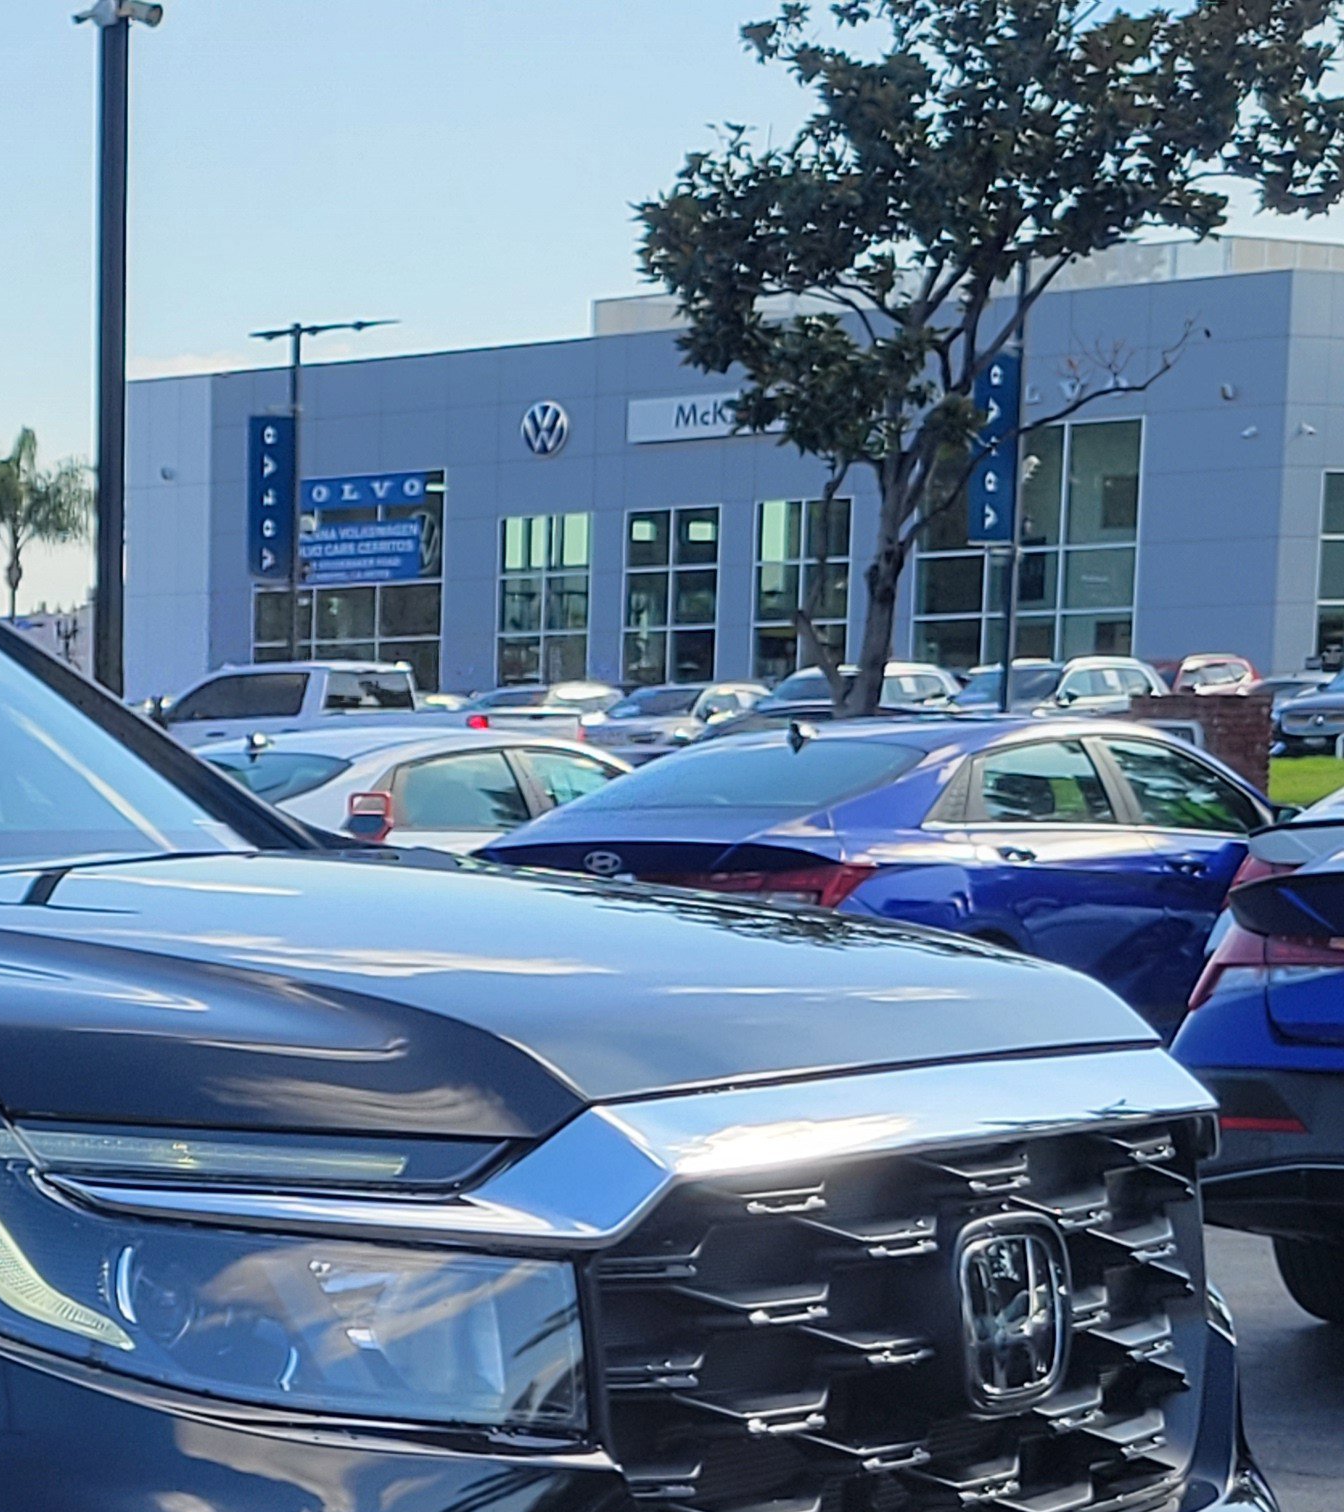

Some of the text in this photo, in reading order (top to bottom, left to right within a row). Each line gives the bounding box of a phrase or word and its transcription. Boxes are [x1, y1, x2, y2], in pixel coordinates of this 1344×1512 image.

[674, 402, 733, 429] McK
[261, 425, 278, 571] VOLVO
[312, 478, 422, 503] OLVO
